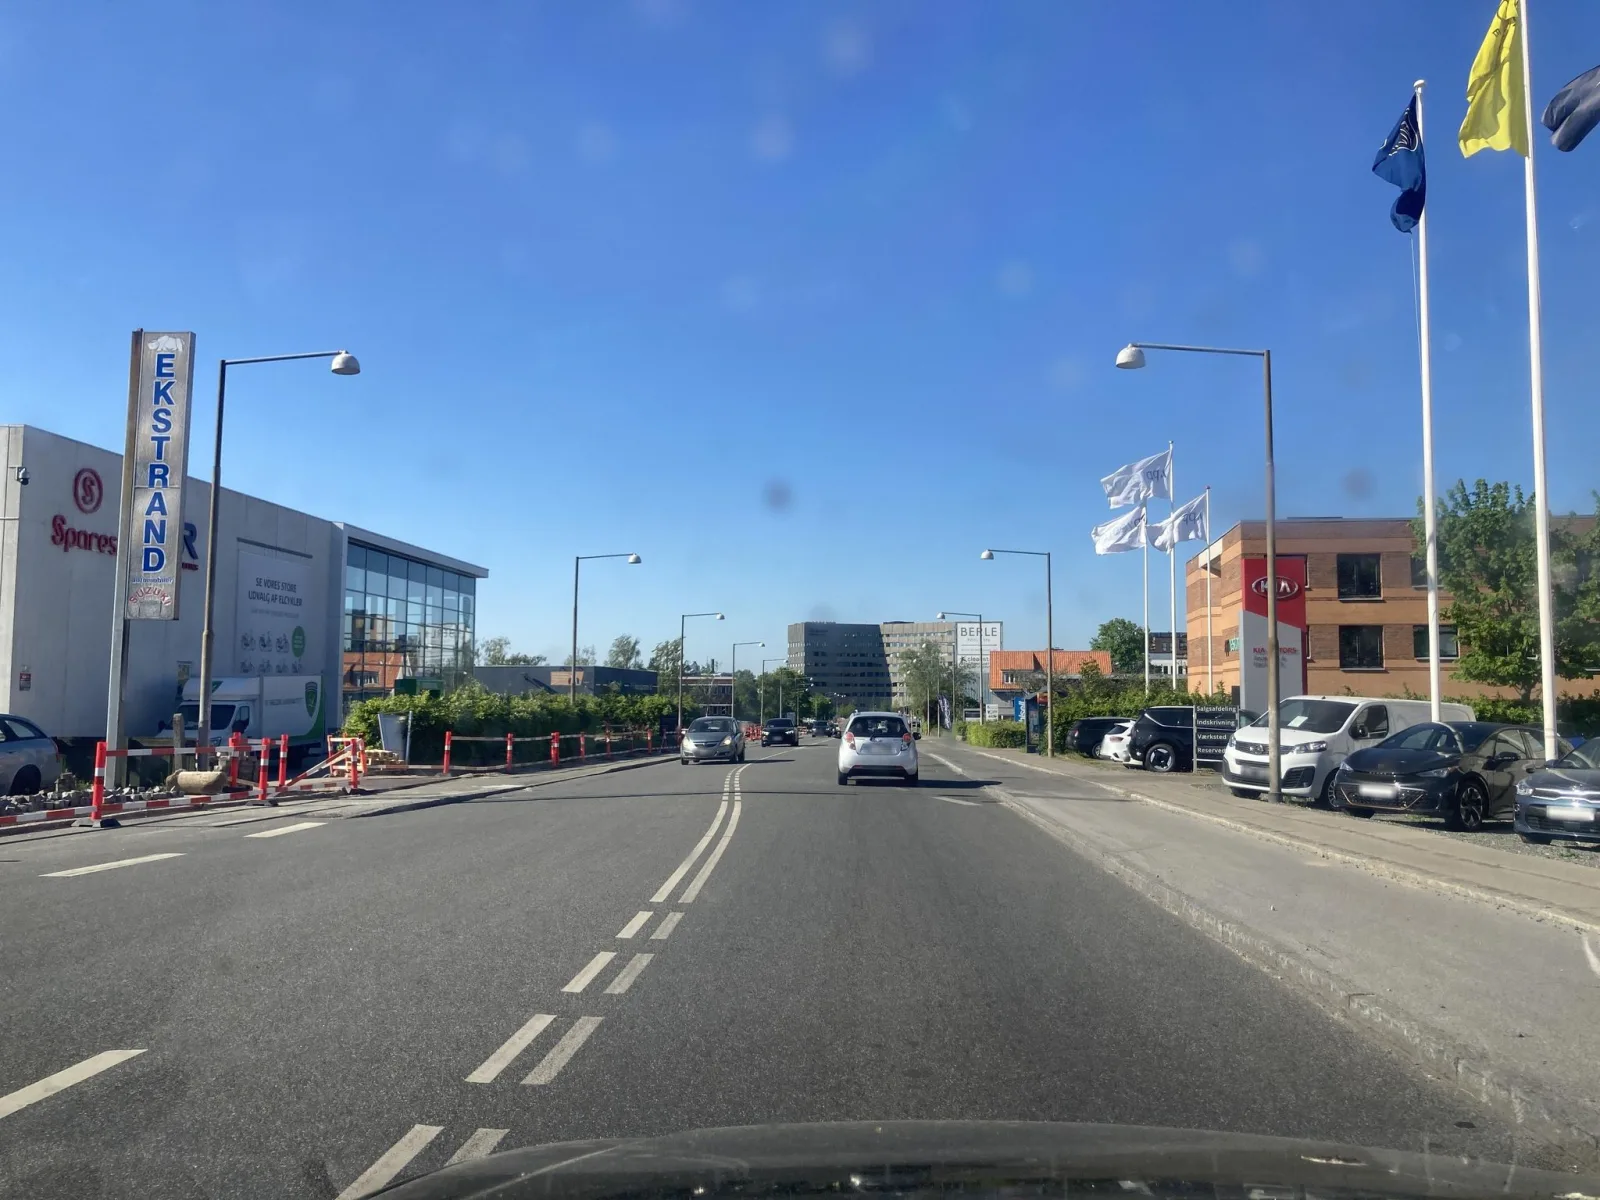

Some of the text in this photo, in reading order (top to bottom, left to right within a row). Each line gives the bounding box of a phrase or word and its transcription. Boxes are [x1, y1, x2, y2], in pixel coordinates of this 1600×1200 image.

[141, 353, 176, 575] EKSTRAND
[255, 577, 297, 594] SE VORES STORE
[129, 586, 172, 606] SUZUKI
[248, 590, 303, 607] UDVALG AF ELCYKLER
[960, 627, 998, 637] BERLE
[1196, 705, 1237, 713] Salgsafdeling
[1196, 719, 1236, 727] Indskrivning
